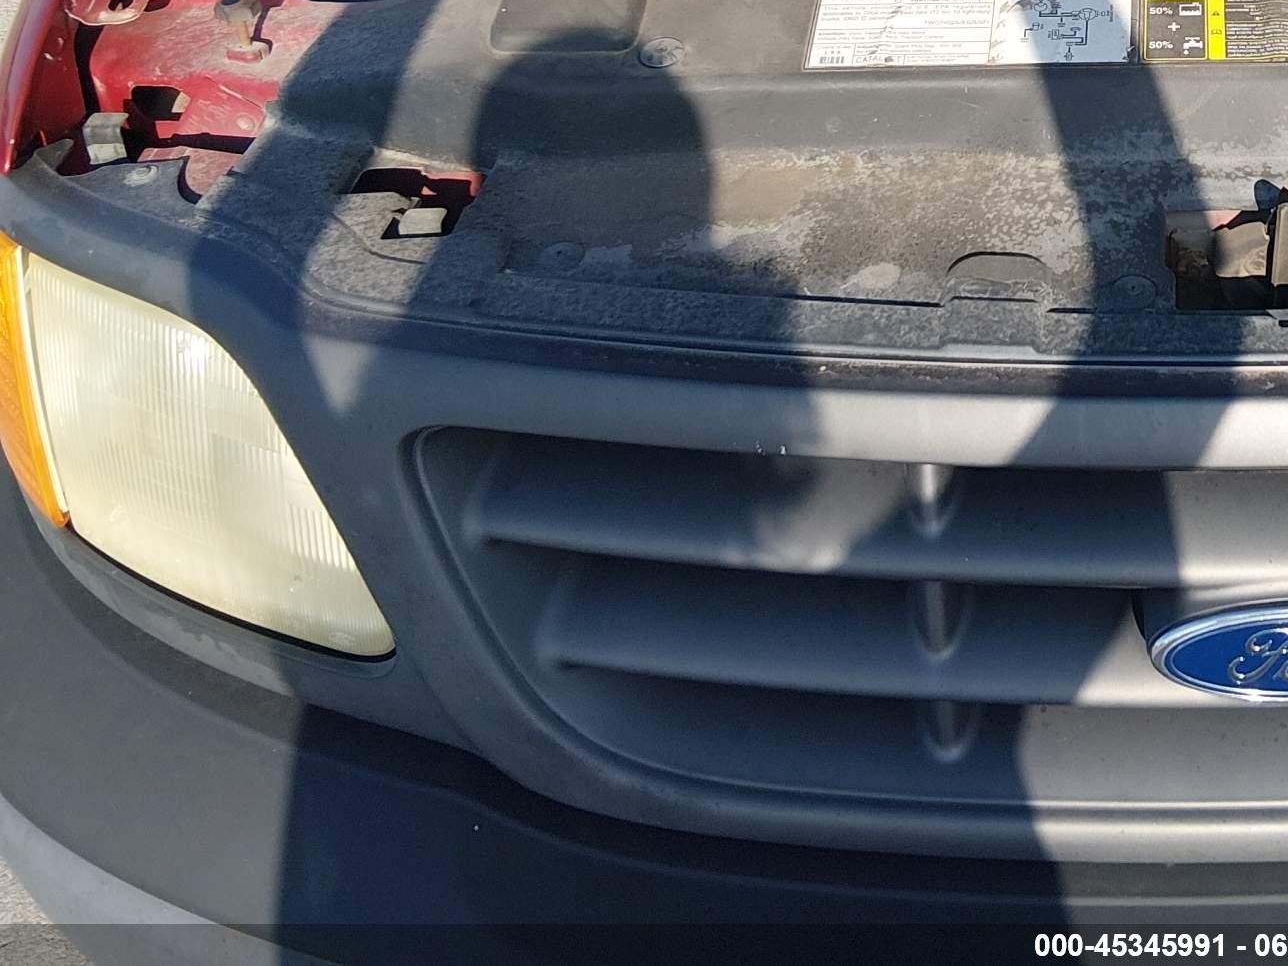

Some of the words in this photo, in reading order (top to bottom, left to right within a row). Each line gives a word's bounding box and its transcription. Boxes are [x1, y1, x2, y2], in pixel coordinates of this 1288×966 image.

[1149, 6, 1174, 15] 50%
[1148, 40, 1174, 50] 50%
[855, 55, 901, 63] CATALT
